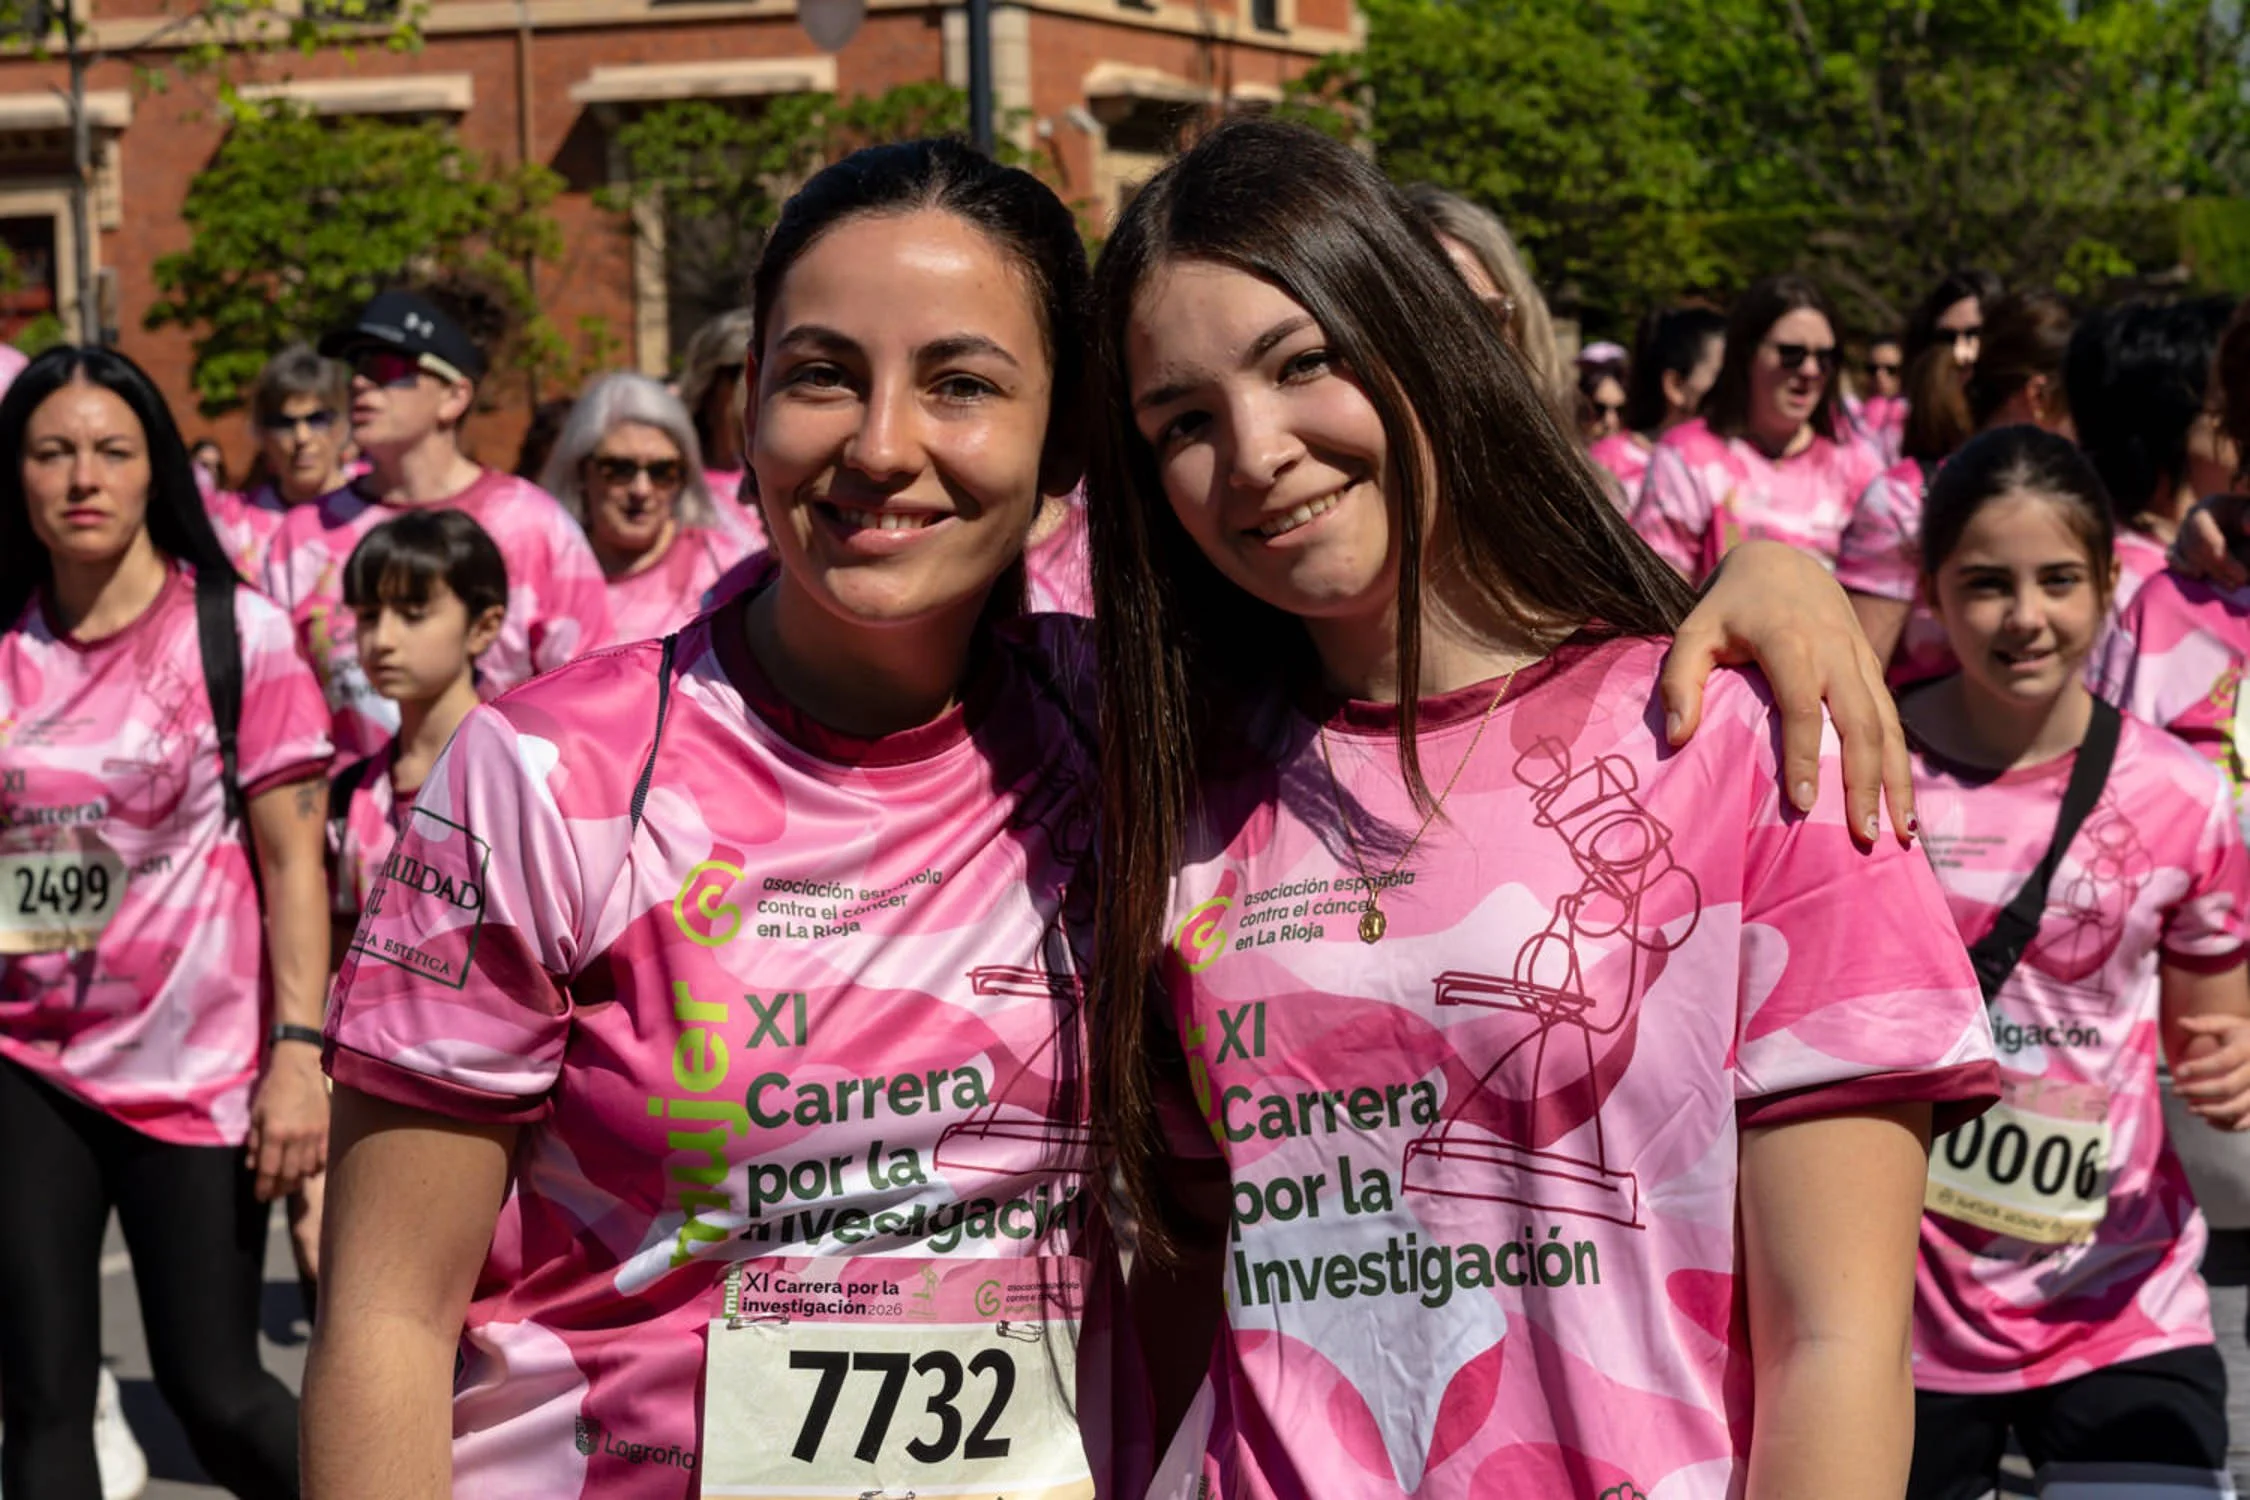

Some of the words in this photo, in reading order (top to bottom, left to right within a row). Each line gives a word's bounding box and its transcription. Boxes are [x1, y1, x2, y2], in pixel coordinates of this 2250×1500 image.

[3, 768, 26, 792] XI
[7, 800, 105, 825] Carrera
[15, 863, 110, 915] 2499
[763, 876, 854, 901] asociación
[1244, 878, 1329, 907] asociación
[757, 899, 817, 919] contra
[821, 905, 838, 920] el
[1239, 906, 1289, 929] contra
[1293, 900, 1309, 918] el
[1313, 897, 1369, 915] cánce
[757, 923, 781, 938] en
[786, 921, 809, 939] La
[813, 920, 861, 939] Rioja
[1235, 935, 1254, 951] en
[1257, 930, 1276, 946] La
[1280, 922, 1325, 943] Rioja
[744, 993, 807, 1049] XI
[1215, 1001, 1267, 1064] XI
[746, 1066, 990, 1130] Carrera
[1221, 1078, 1441, 1144] Carrera
[748, 1155, 853, 1218] por
[866, 1140, 928, 1189] la
[1230, 1170, 1326, 1243] por
[1338, 1155, 1393, 1222] la
[743, 1271, 769, 1293] XI
[774, 1279, 842, 1294] Carrera
[847, 1282, 879, 1298] por
[882, 1280, 900, 1296] la
[1233, 1225, 1601, 1310] Investigación
[742, 1297, 867, 1318] investigación
[868, 1302, 903, 1317] 2026
[788, 1347, 1017, 1465] 7732
[604, 1431, 697, 1470] Logroño
